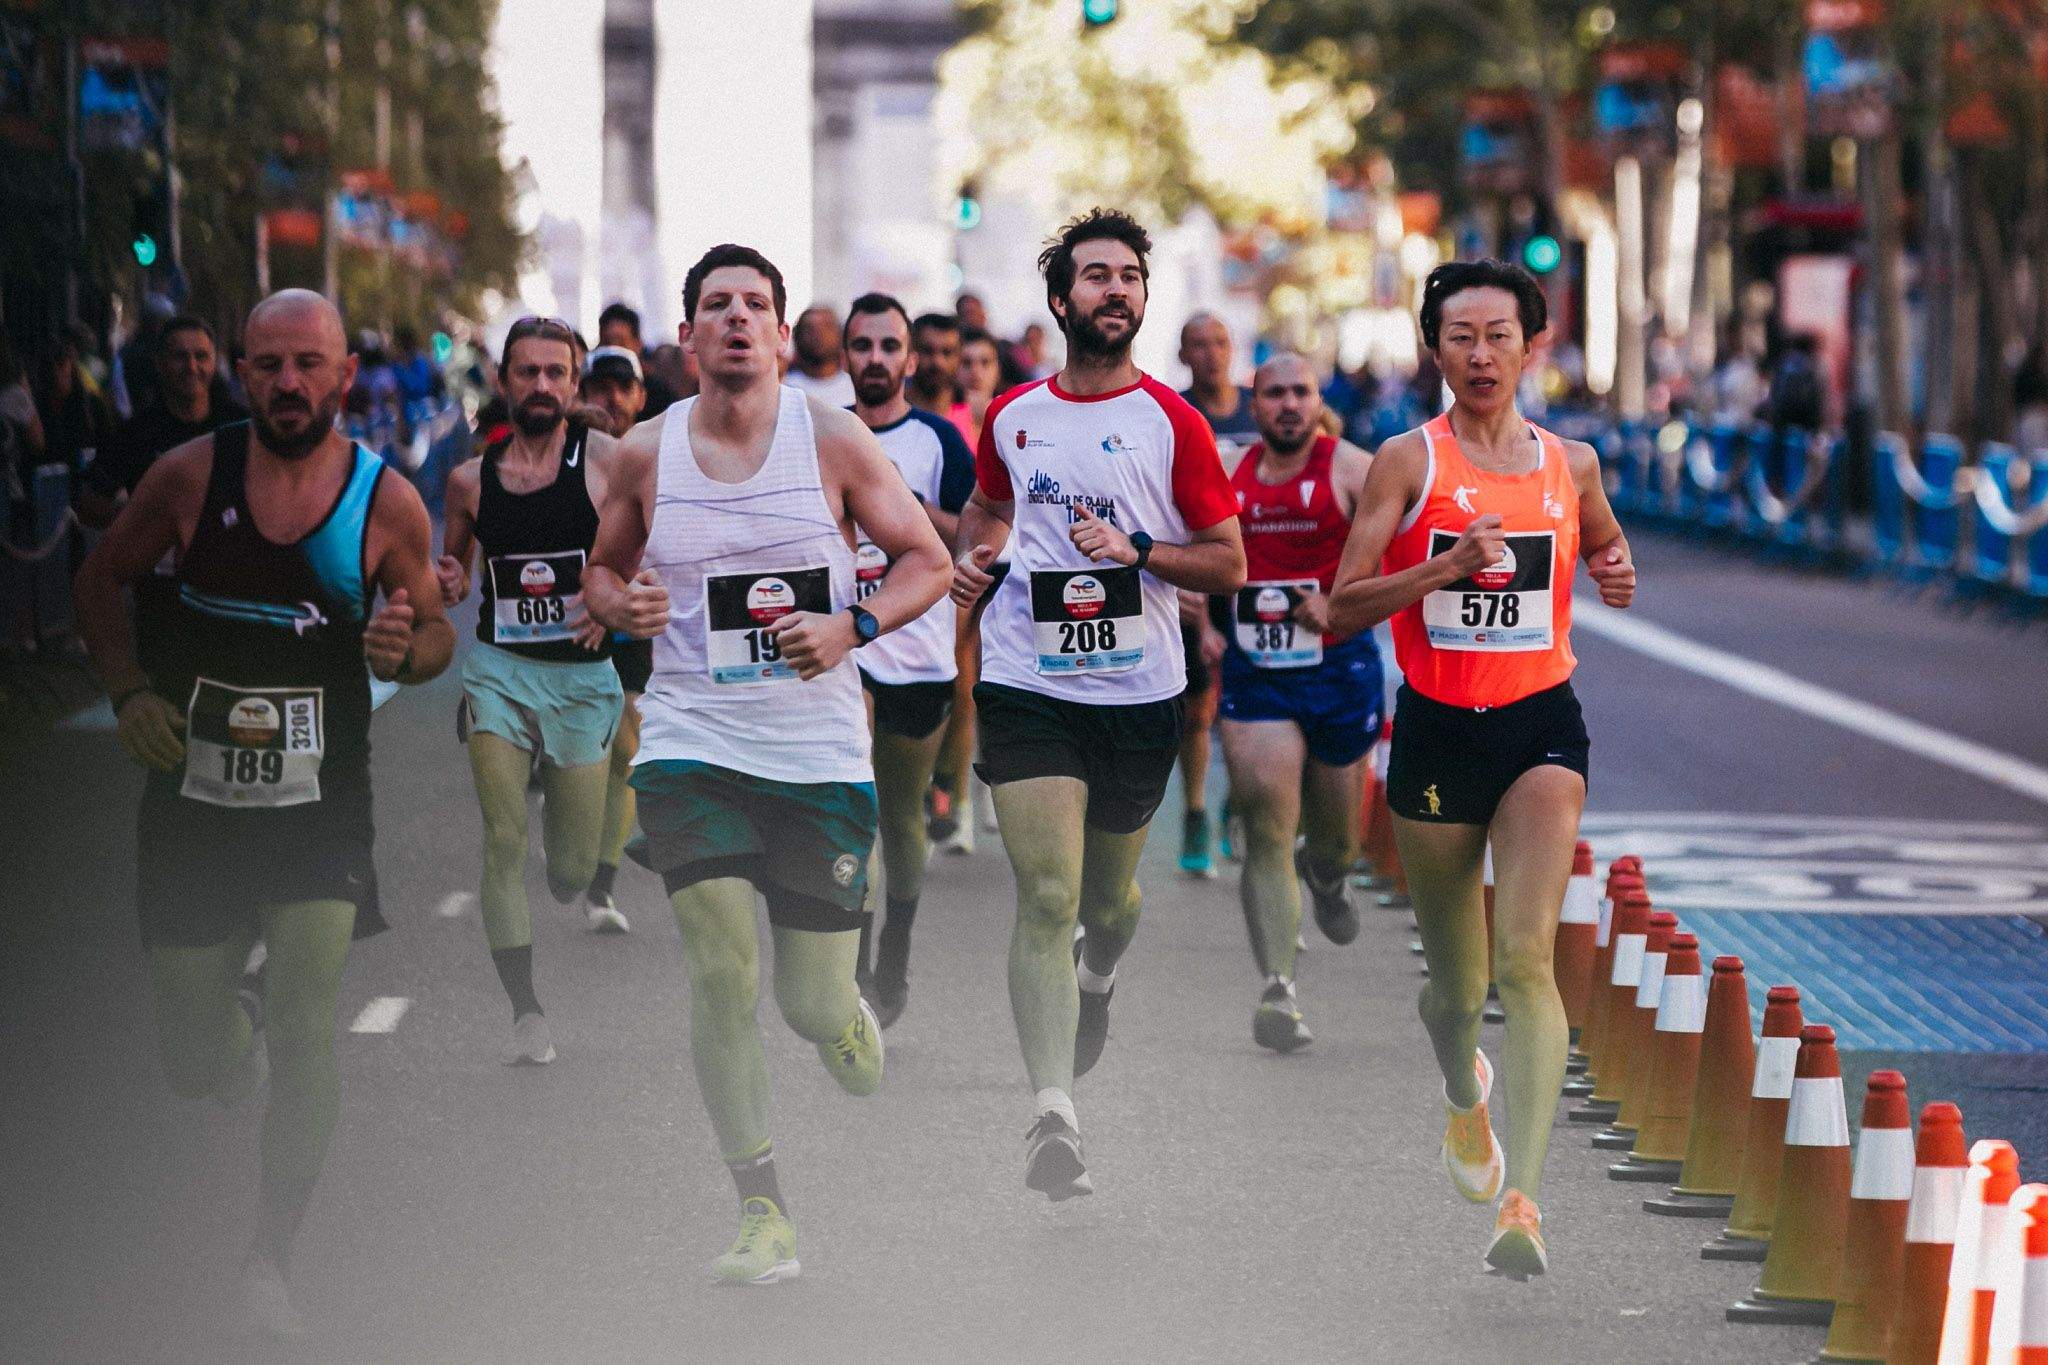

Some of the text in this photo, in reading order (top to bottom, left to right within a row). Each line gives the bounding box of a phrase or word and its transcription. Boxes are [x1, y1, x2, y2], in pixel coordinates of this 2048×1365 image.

[1028, 469, 1060, 494] CAMPO
[1045, 493, 1071, 506] VILLAR
[1085, 496, 1115, 509] OLALLA
[517, 597, 565, 625] 603
[1461, 593, 1519, 628] 578
[1059, 620, 1117, 653] 208
[1256, 624, 1295, 650] 387
[291, 703, 311, 750] 3206
[221, 749, 284, 785] 189
